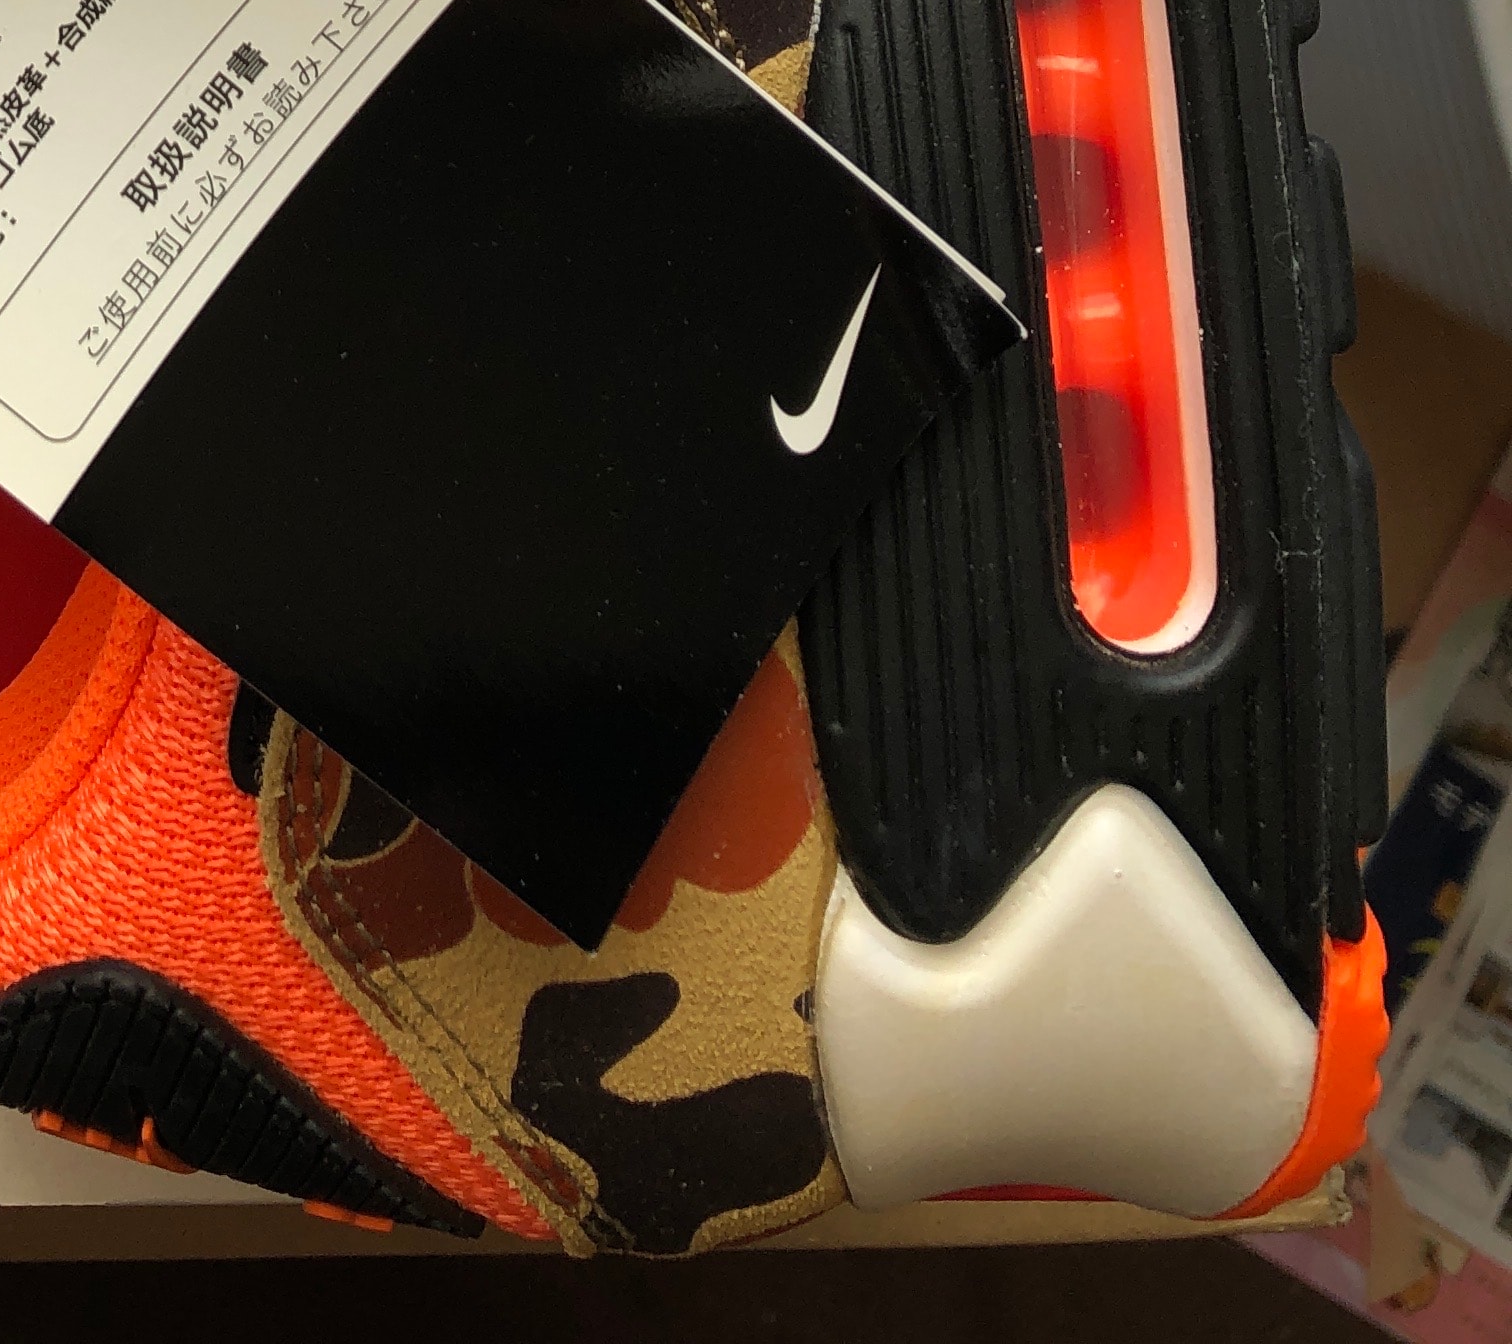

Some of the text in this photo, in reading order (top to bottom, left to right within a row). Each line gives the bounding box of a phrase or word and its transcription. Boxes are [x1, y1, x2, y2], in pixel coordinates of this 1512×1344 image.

[120, 41, 269, 214] 取扱説明書
